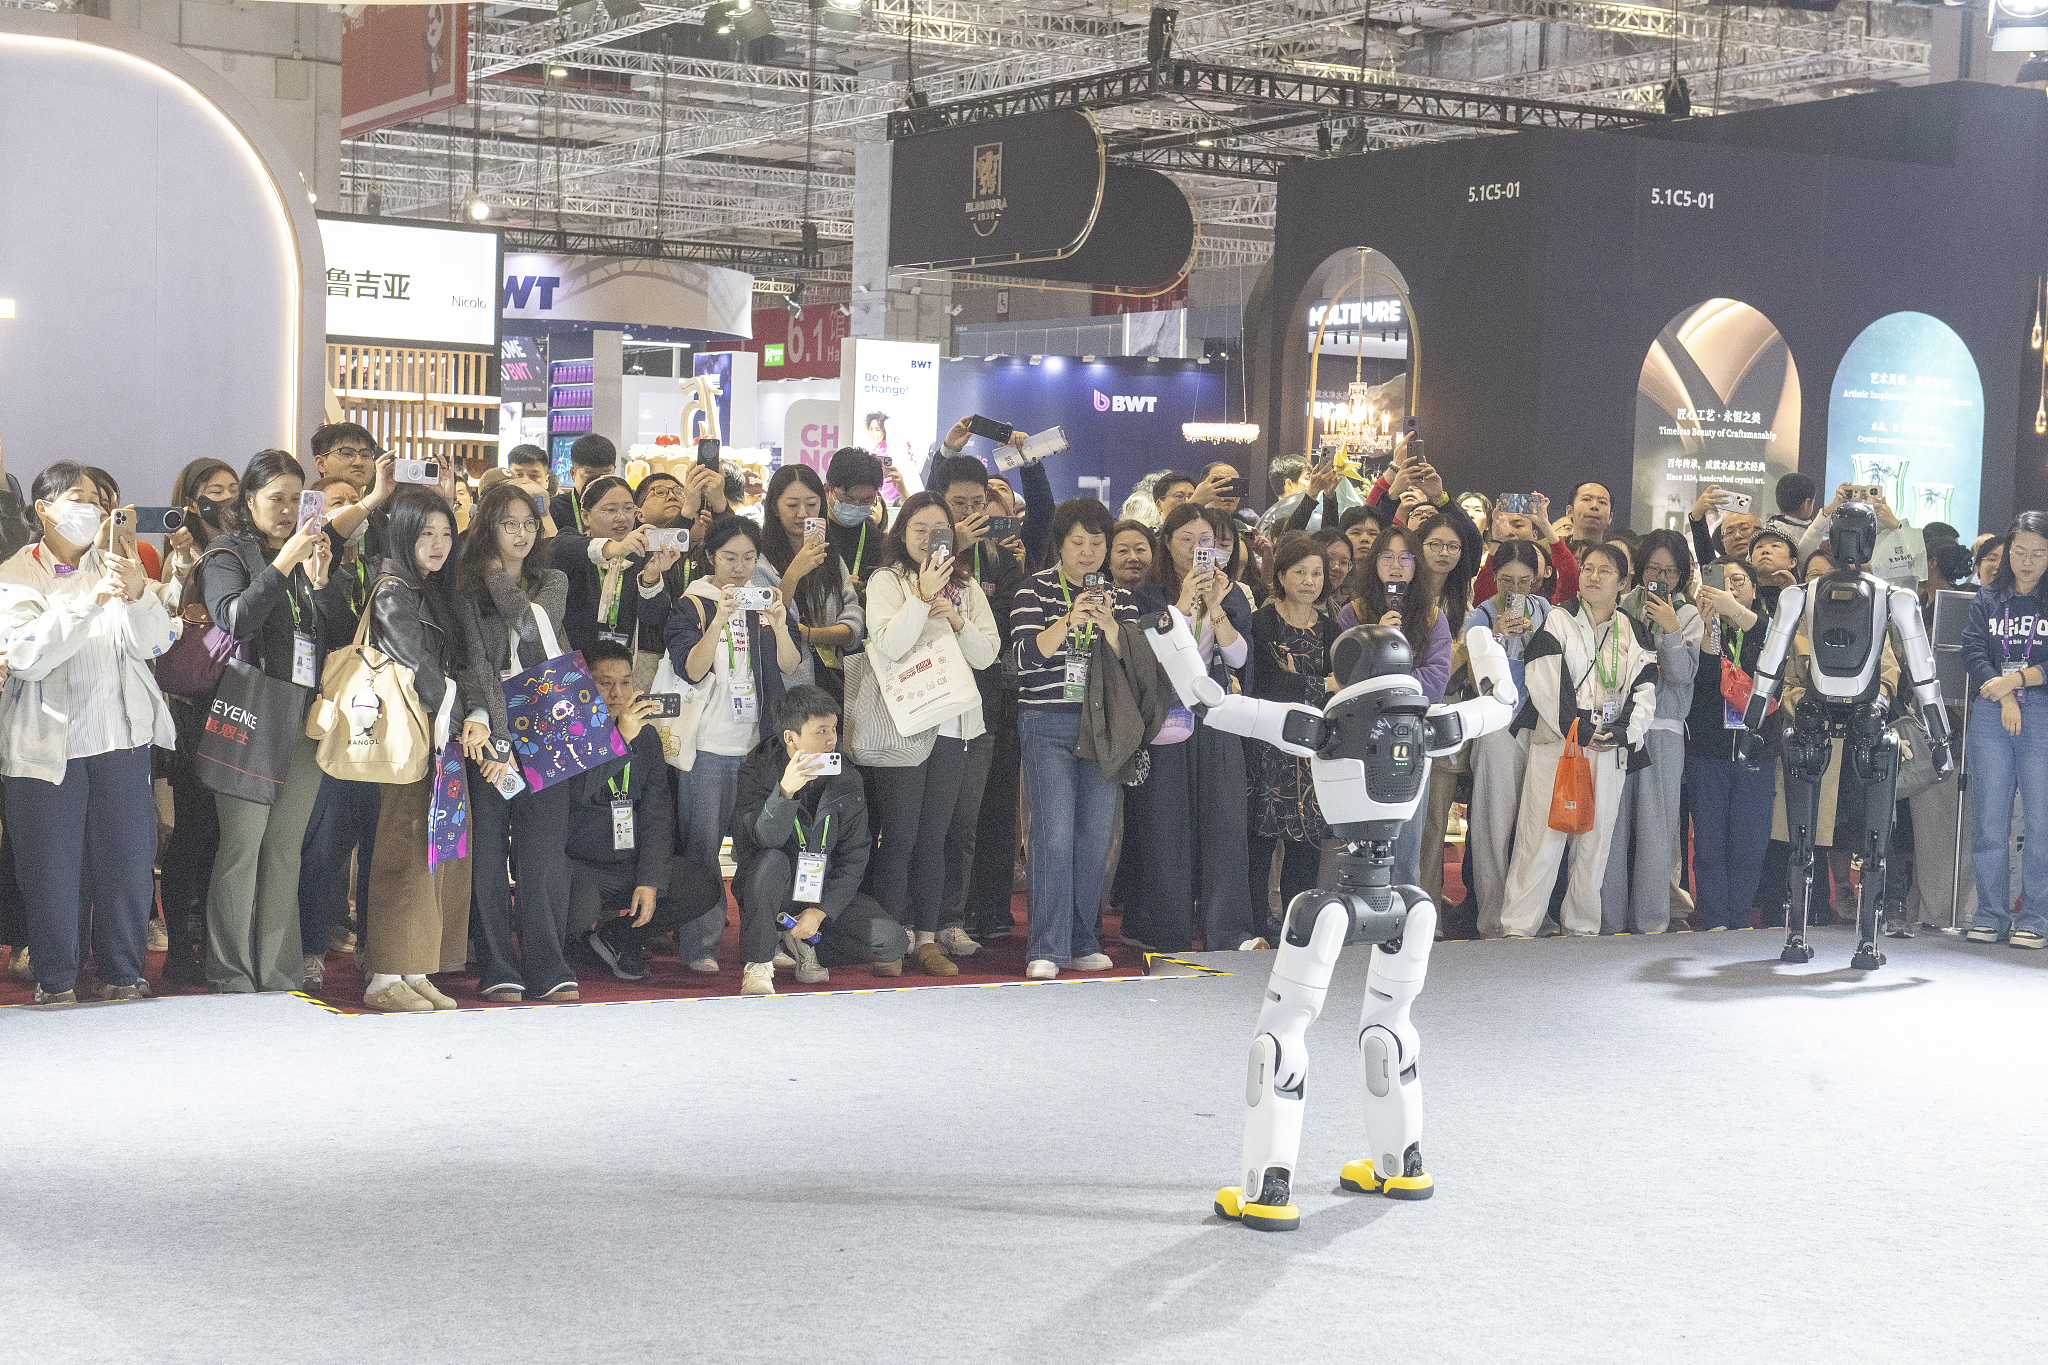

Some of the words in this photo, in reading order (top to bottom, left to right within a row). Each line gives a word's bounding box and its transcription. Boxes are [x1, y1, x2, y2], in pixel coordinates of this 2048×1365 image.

[1468, 181, 1521, 203] 5.1C5-01
[1650, 188, 1715, 210] 5.1C5-01
[326, 267, 411, 300] 鲁吉亚
[452, 295, 487, 309] Nicolo
[1309, 301, 1401, 326] MULTIPURE
[787, 308, 823, 363] 6.1
[505, 362, 533, 381] BWT
[911, 360, 932, 369] BWT
[865, 373, 879, 382] Be
[882, 374, 900, 383] the
[864, 384, 909, 396] change!
[1843, 389, 1869, 398] Artistic
[1870, 391, 1907, 401] Inspiration
[1112, 395, 1157, 412] BWT
[800, 424, 839, 448] CH
[1659, 426, 1690, 436] Timeless
[1692, 427, 1716, 439] Beauty
[1717, 428, 1725, 437] of
[1726, 429, 1777, 442] Craftsmanship
[1857, 435, 1877, 444] Crystal
[1666, 473, 1682, 481] Since
[1699, 474, 1734, 484] handcrafted
[1734, 475, 1754, 485] crystal
[211, 699, 258, 730] EYENCE
[347, 738, 379, 746] KANGOL
